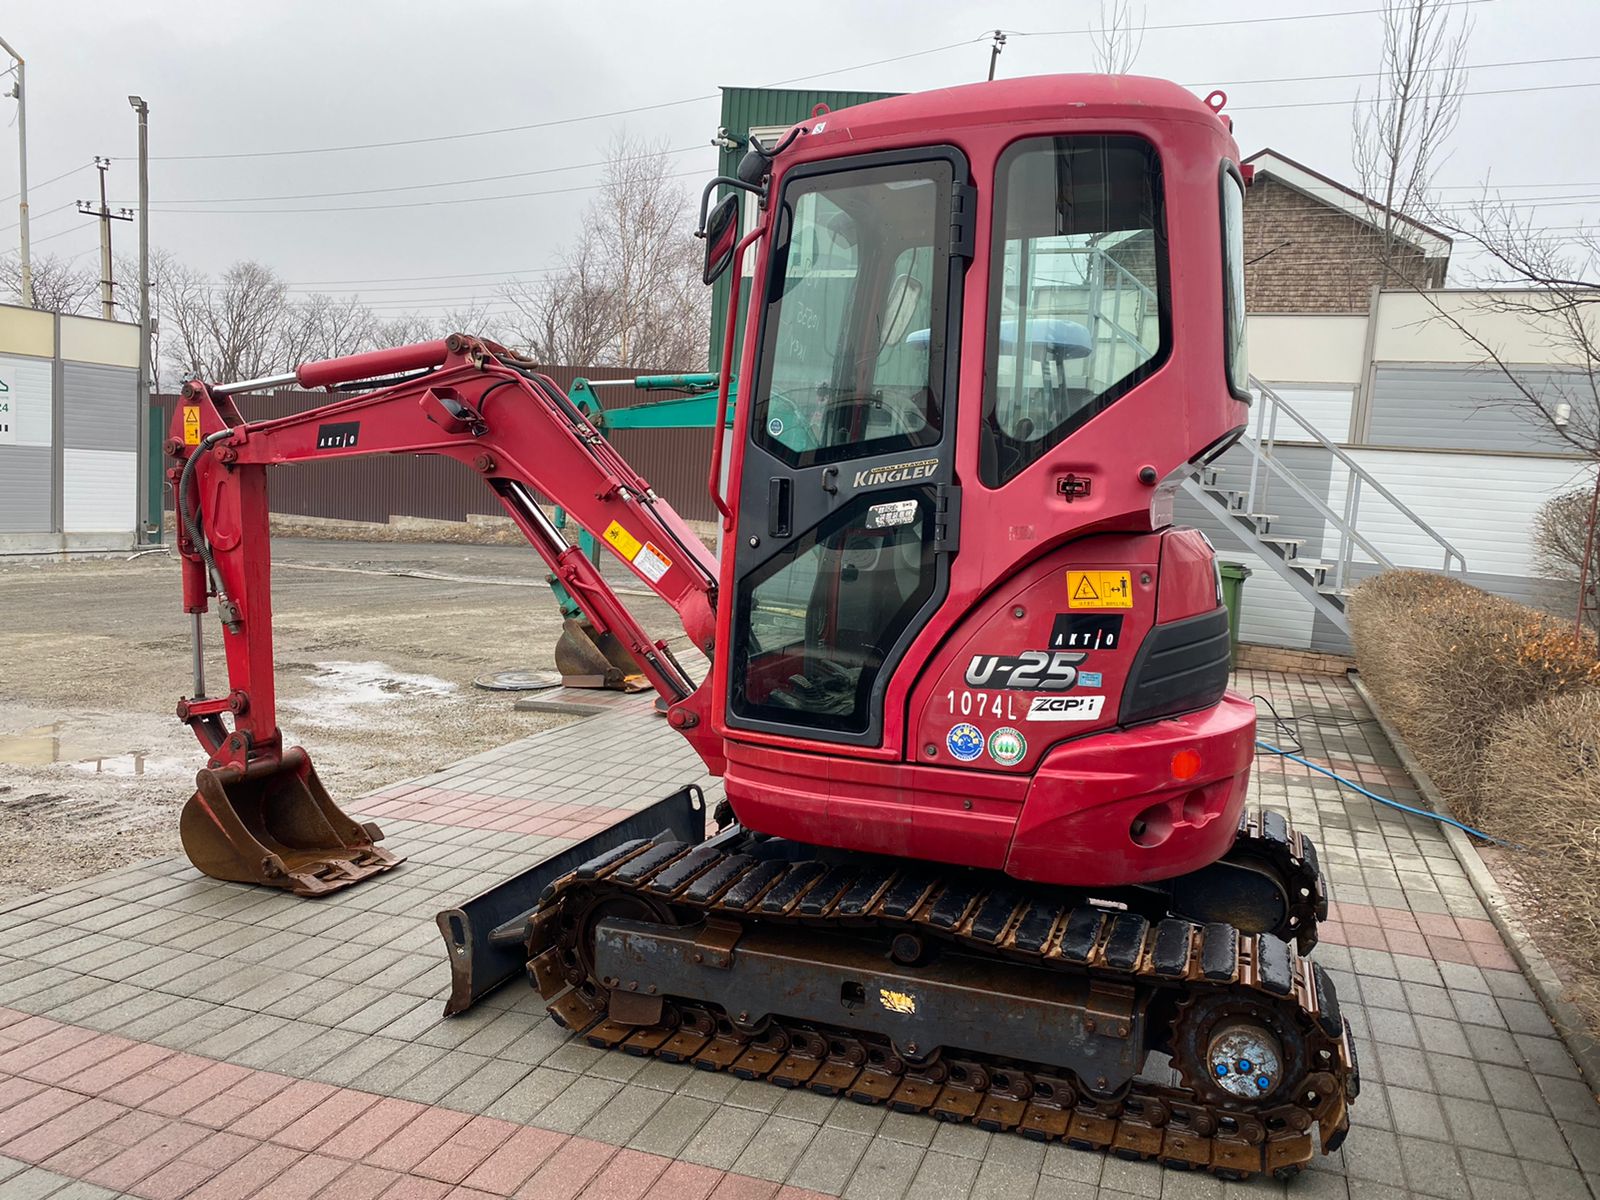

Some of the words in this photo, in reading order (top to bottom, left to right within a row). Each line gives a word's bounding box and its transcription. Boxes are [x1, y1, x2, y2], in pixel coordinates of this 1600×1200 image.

[853, 463, 939, 488] KINGLEV
[1055, 629, 1114, 650] AKTIO
[965, 651, 1087, 689] U-25
[947, 690, 1017, 720] 1074L
